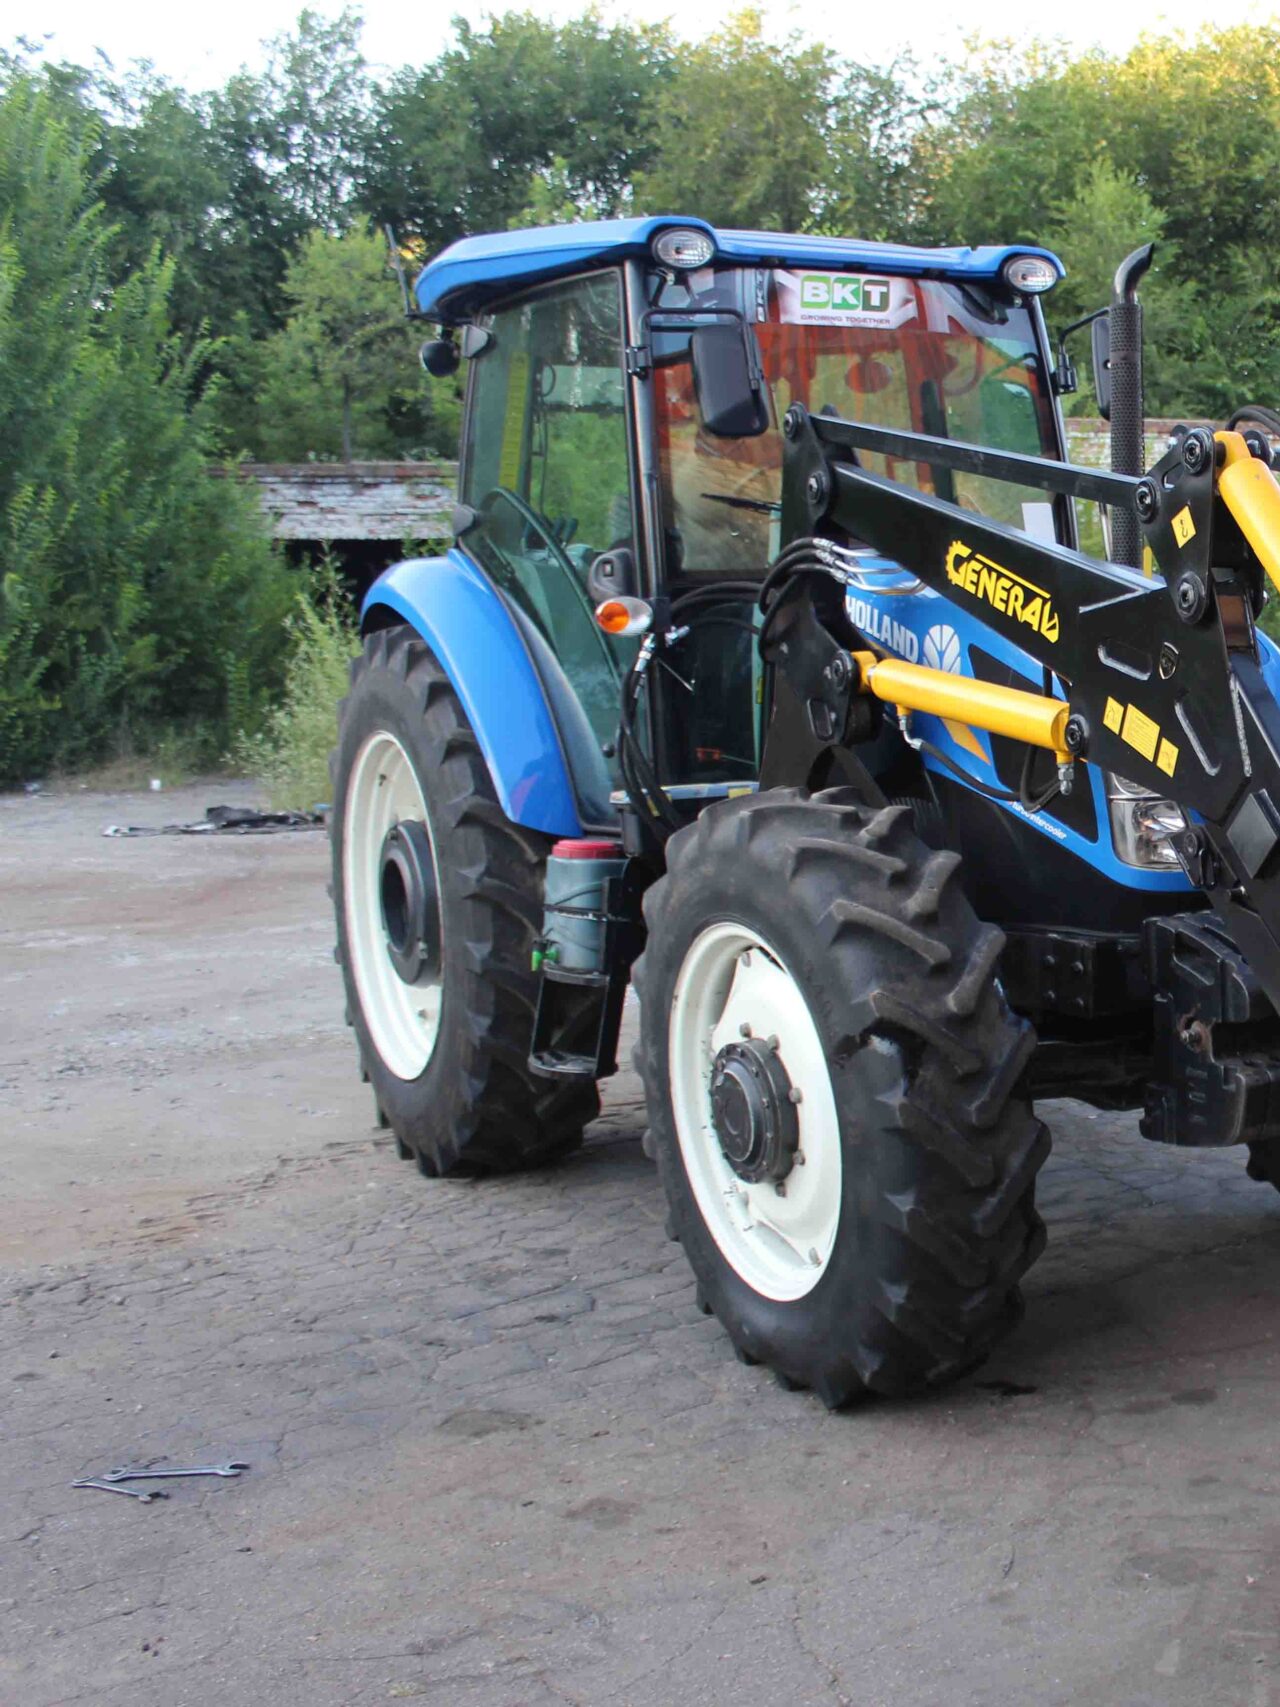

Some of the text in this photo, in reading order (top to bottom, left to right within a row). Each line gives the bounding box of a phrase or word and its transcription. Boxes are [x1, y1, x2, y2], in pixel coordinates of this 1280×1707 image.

[802, 279, 888, 308] BKT
[845, 316, 891, 325] TOGETHER
[945, 540, 1060, 643] GENERAL
[845, 594, 919, 664] HOLLAND
